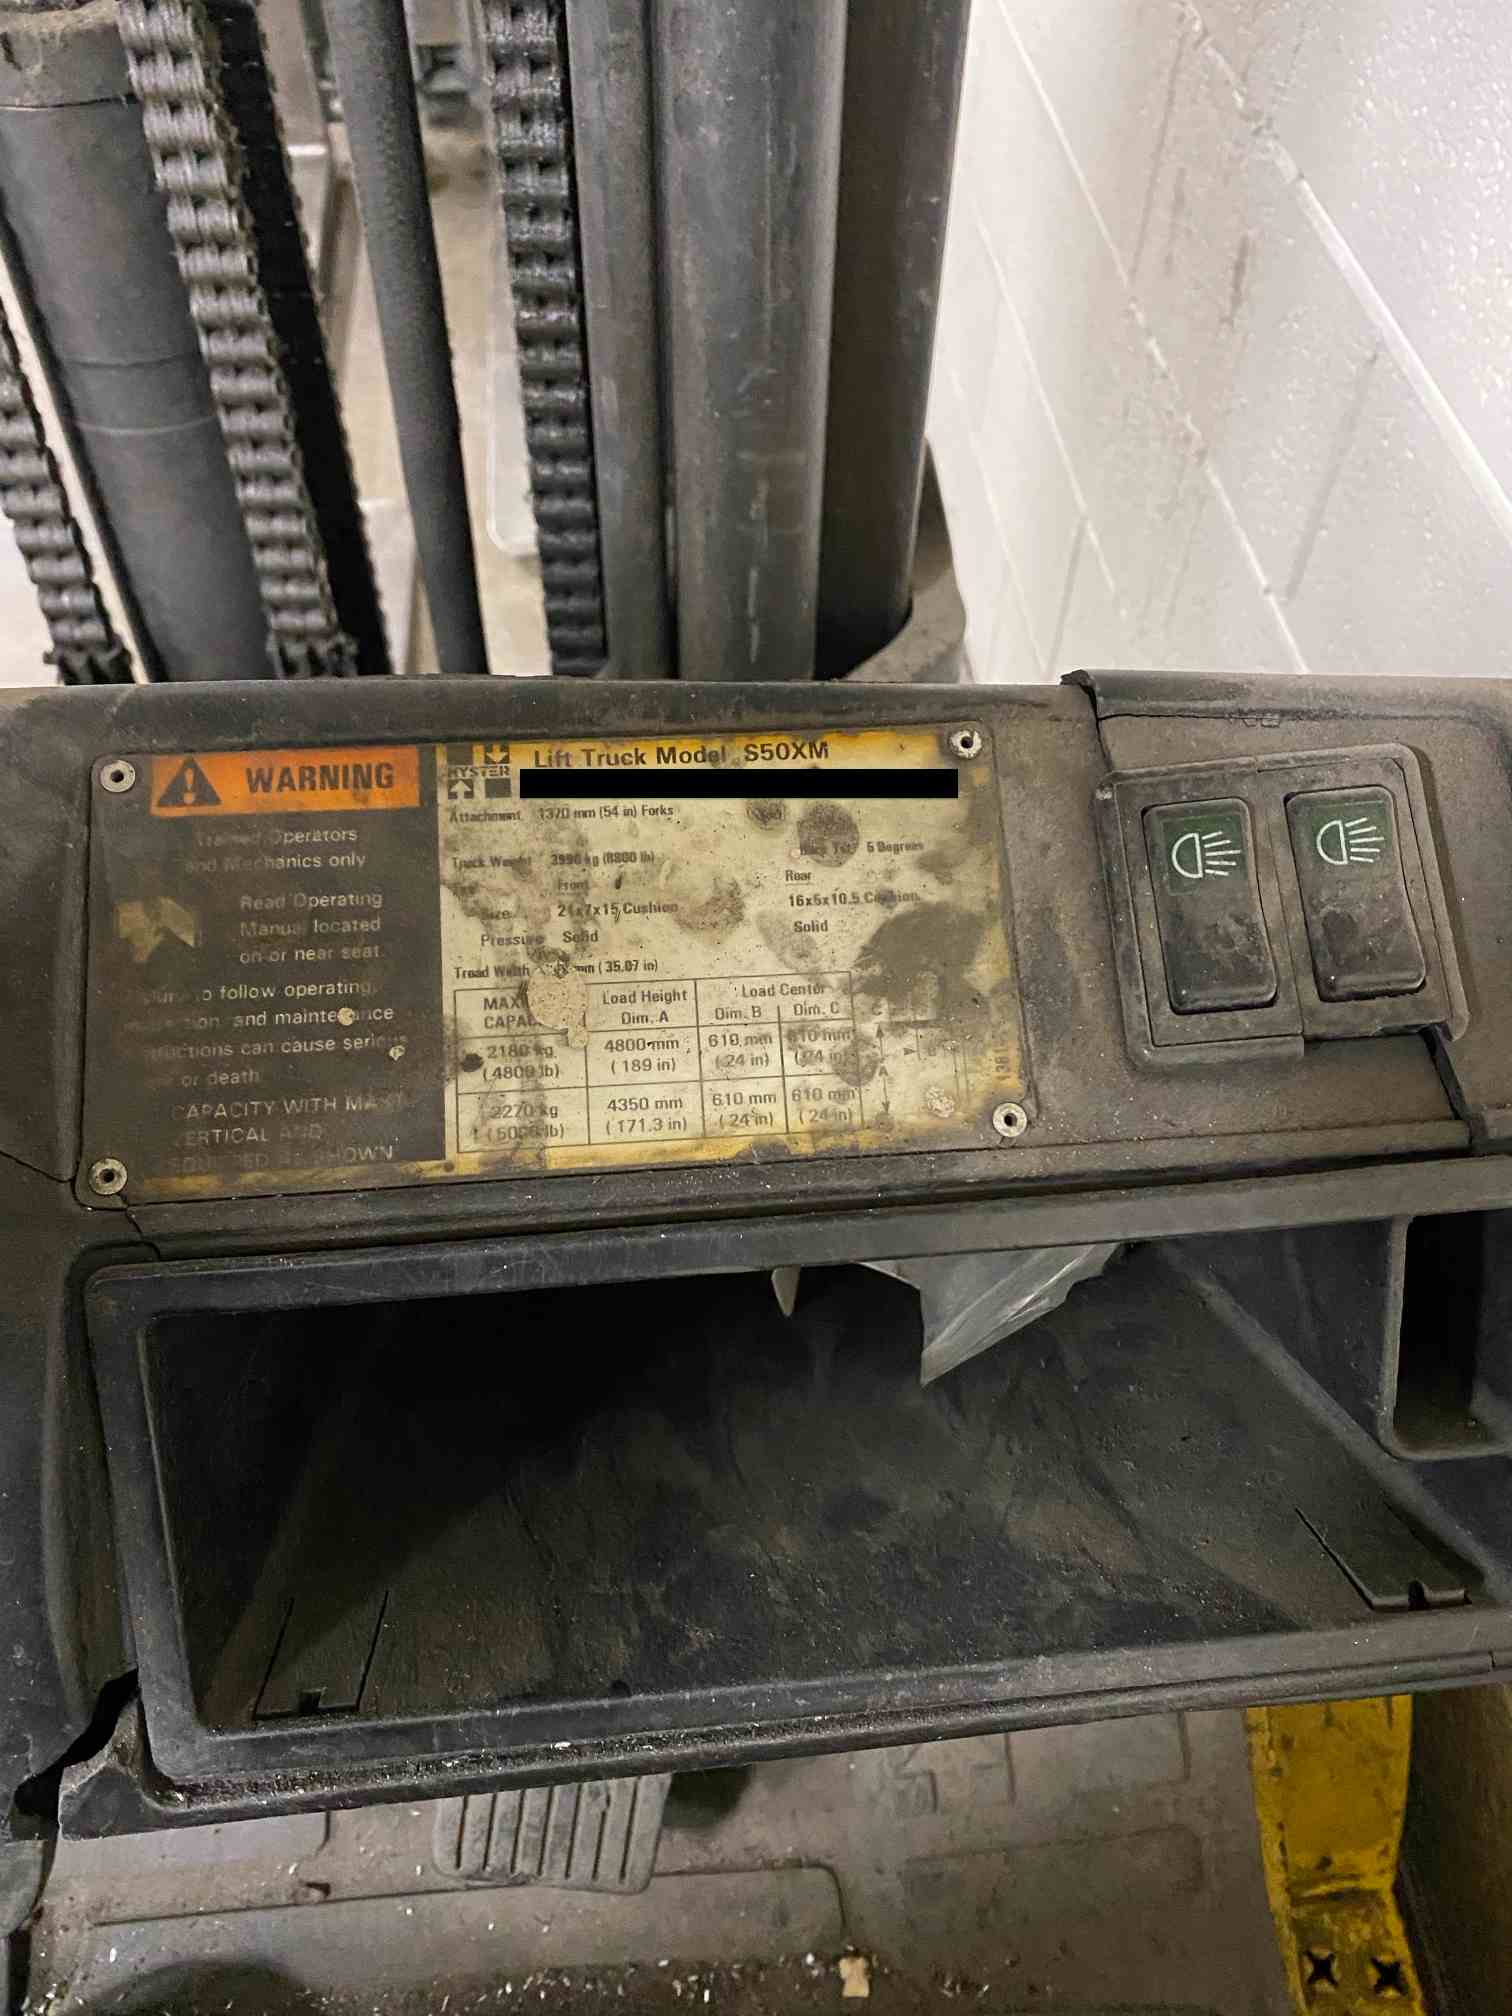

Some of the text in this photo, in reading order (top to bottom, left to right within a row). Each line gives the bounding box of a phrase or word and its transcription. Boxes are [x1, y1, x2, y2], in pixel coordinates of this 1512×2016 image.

[534, 741, 830, 768] Lift Truck Model S50XM
[245, 763, 395, 792] WARNING
[641, 805, 674, 817] Forks
[272, 828, 358, 845] Operators
[329, 852, 366, 870] only
[785, 870, 812, 882] Rear
[294, 891, 383, 910] Operating
[313, 916, 381, 934] located
[794, 920, 829, 932] Solid
[268, 948, 287, 962] or
[294, 947, 333, 962] near
[455, 966, 488, 979] Tread
[220, 985, 274, 1000] follow
[602, 989, 687, 1004] Load Height
[742, 983, 825, 997] Load Center
[751, 1006, 762, 1018] B
[830, 1002, 840, 1014] C
[233, 1011, 266, 1028] and
[659, 1010, 669, 1023] A
[744, 1034, 772, 1046] mm
[822, 1029, 850, 1042] mm
[281, 1037, 335, 1054] cause
[604, 1038, 680, 1052] 4800 mm
[656, 1059, 676, 1072] in)
[712, 1093, 777, 1107] 610 mm
[828, 1089, 855, 1101] mm
[284, 1098, 336, 1115] WITH
[607, 1097, 683, 1112] 4350 mm
[668, 1117, 687, 1131] in)
[178, 1127, 268, 1146] ERTICAL
[318, 1145, 394, 1167] HOWN
